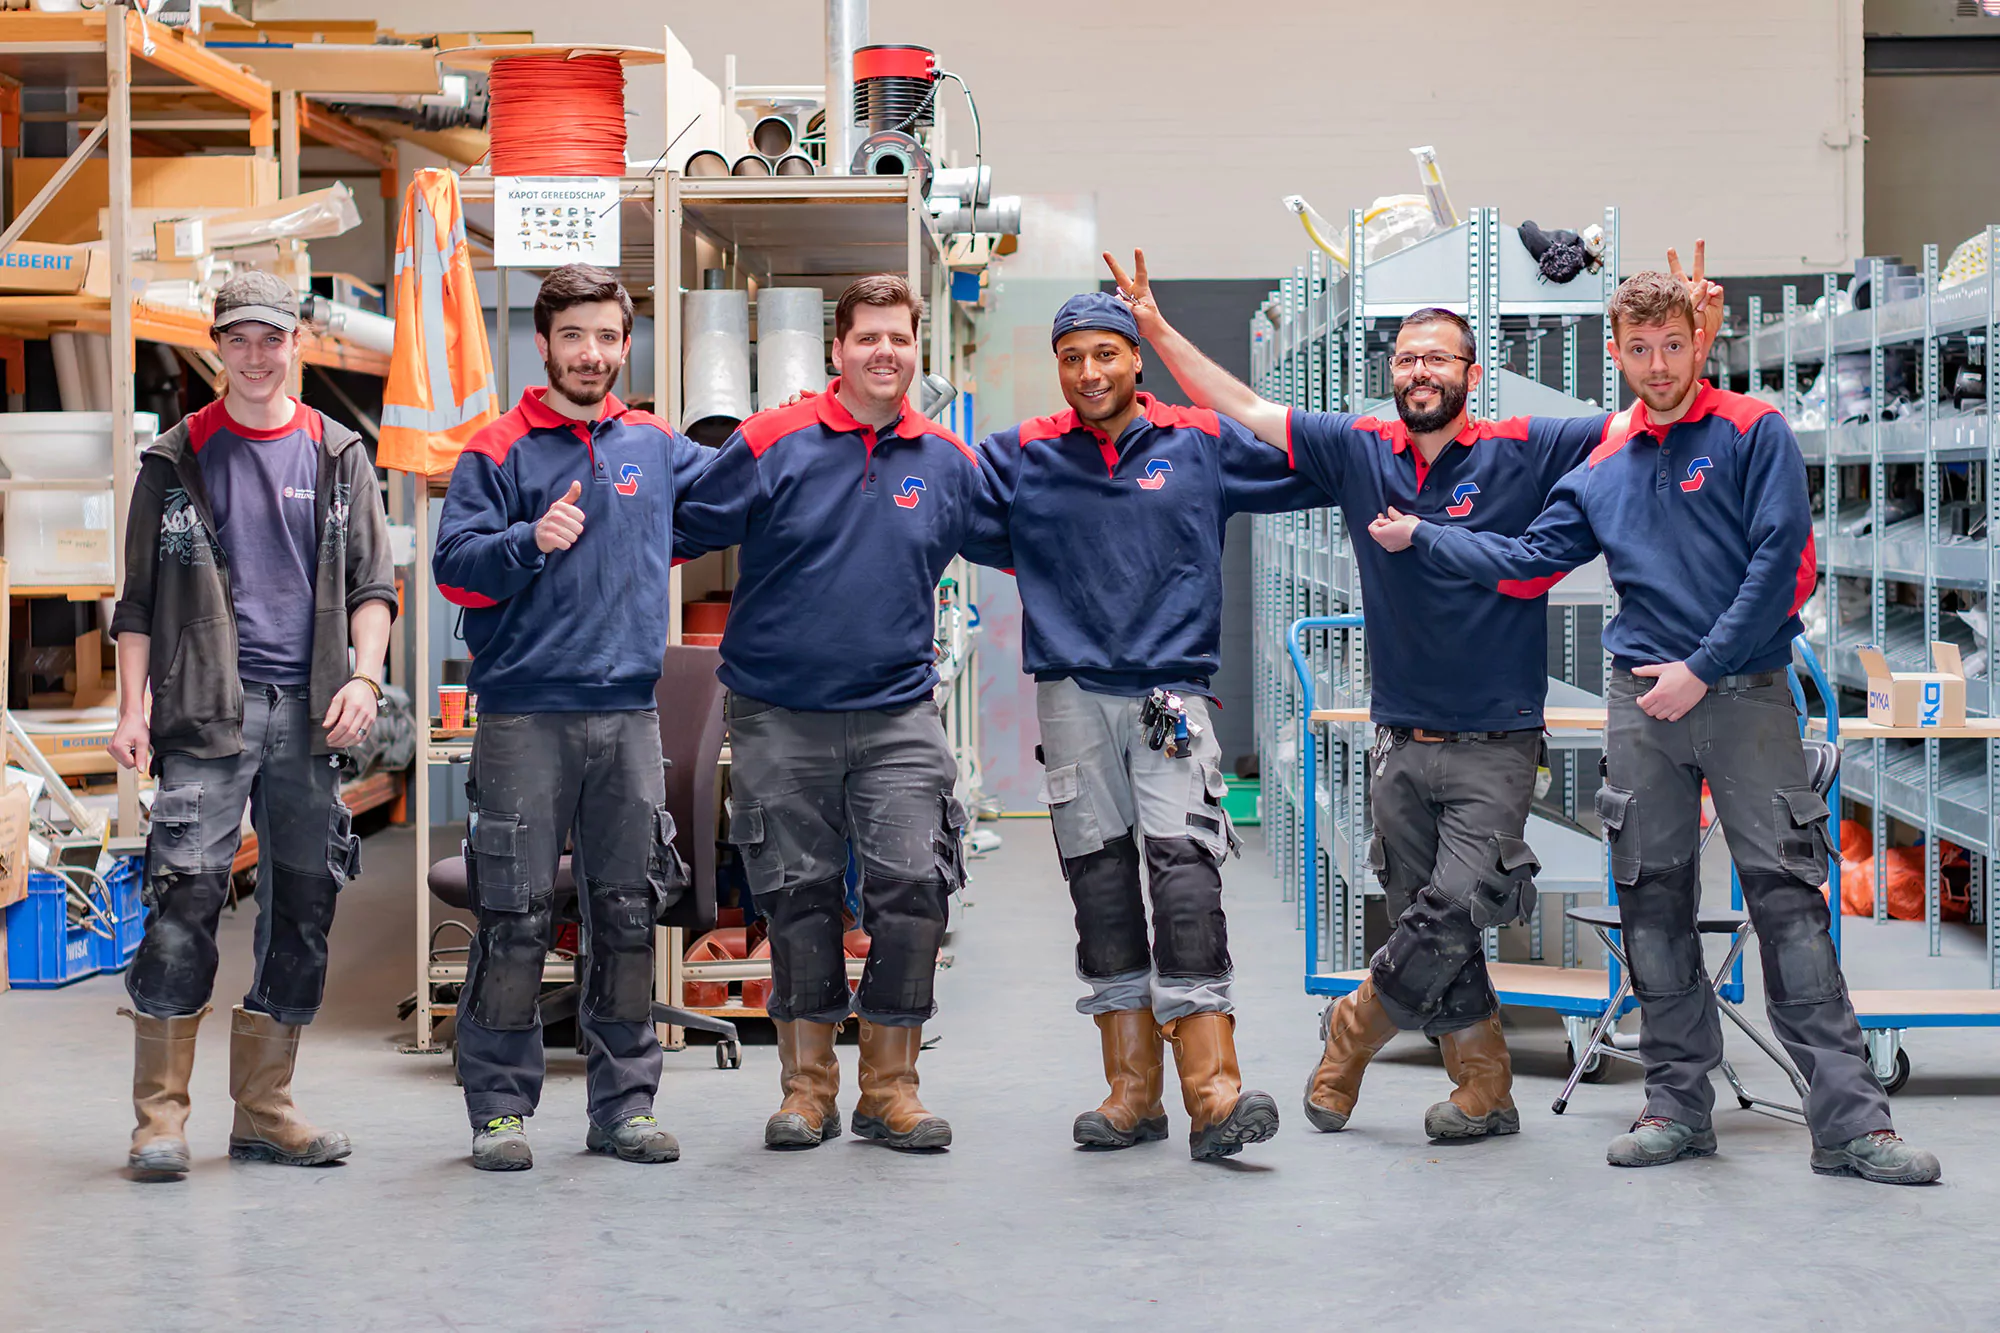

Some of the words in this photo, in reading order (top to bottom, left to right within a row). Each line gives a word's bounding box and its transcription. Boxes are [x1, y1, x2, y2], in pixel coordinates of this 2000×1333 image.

[508, 191, 538, 199] KAPOT
[541, 191, 606, 199] GEREEDSCHAP
[1869, 691, 1890, 710] DYKA
